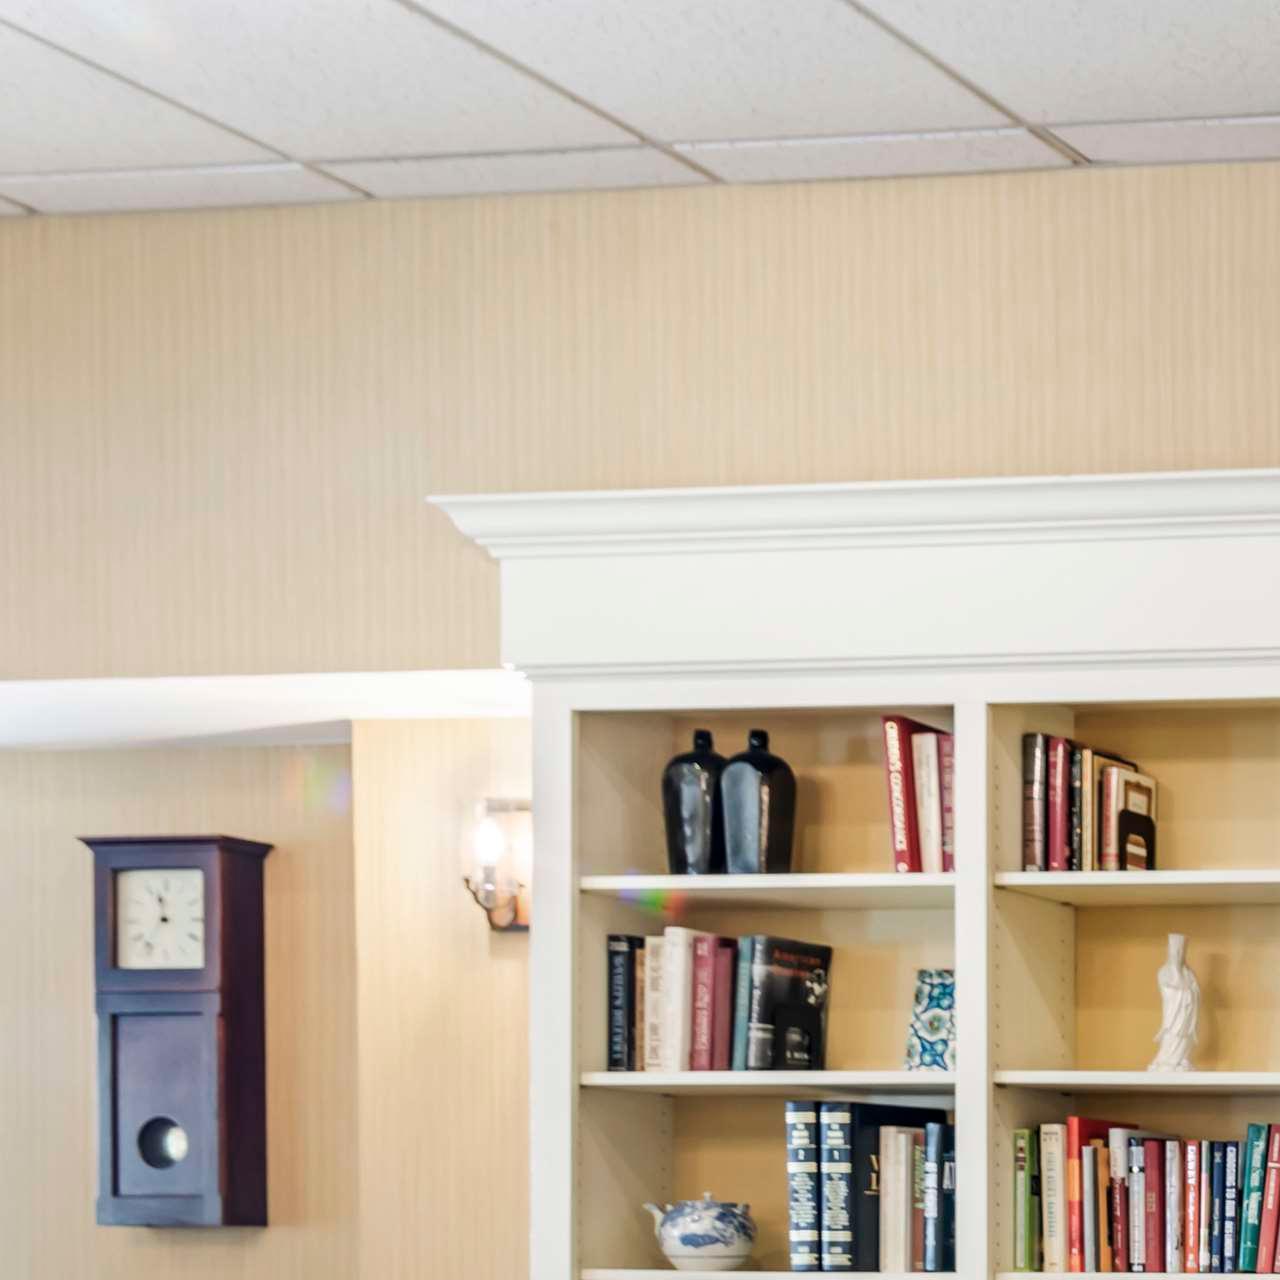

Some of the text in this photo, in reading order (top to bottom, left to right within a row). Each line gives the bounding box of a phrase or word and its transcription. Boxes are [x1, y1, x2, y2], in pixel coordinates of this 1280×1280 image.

[1225, 1146, 1236, 1217] CHOOSING TO RUN
